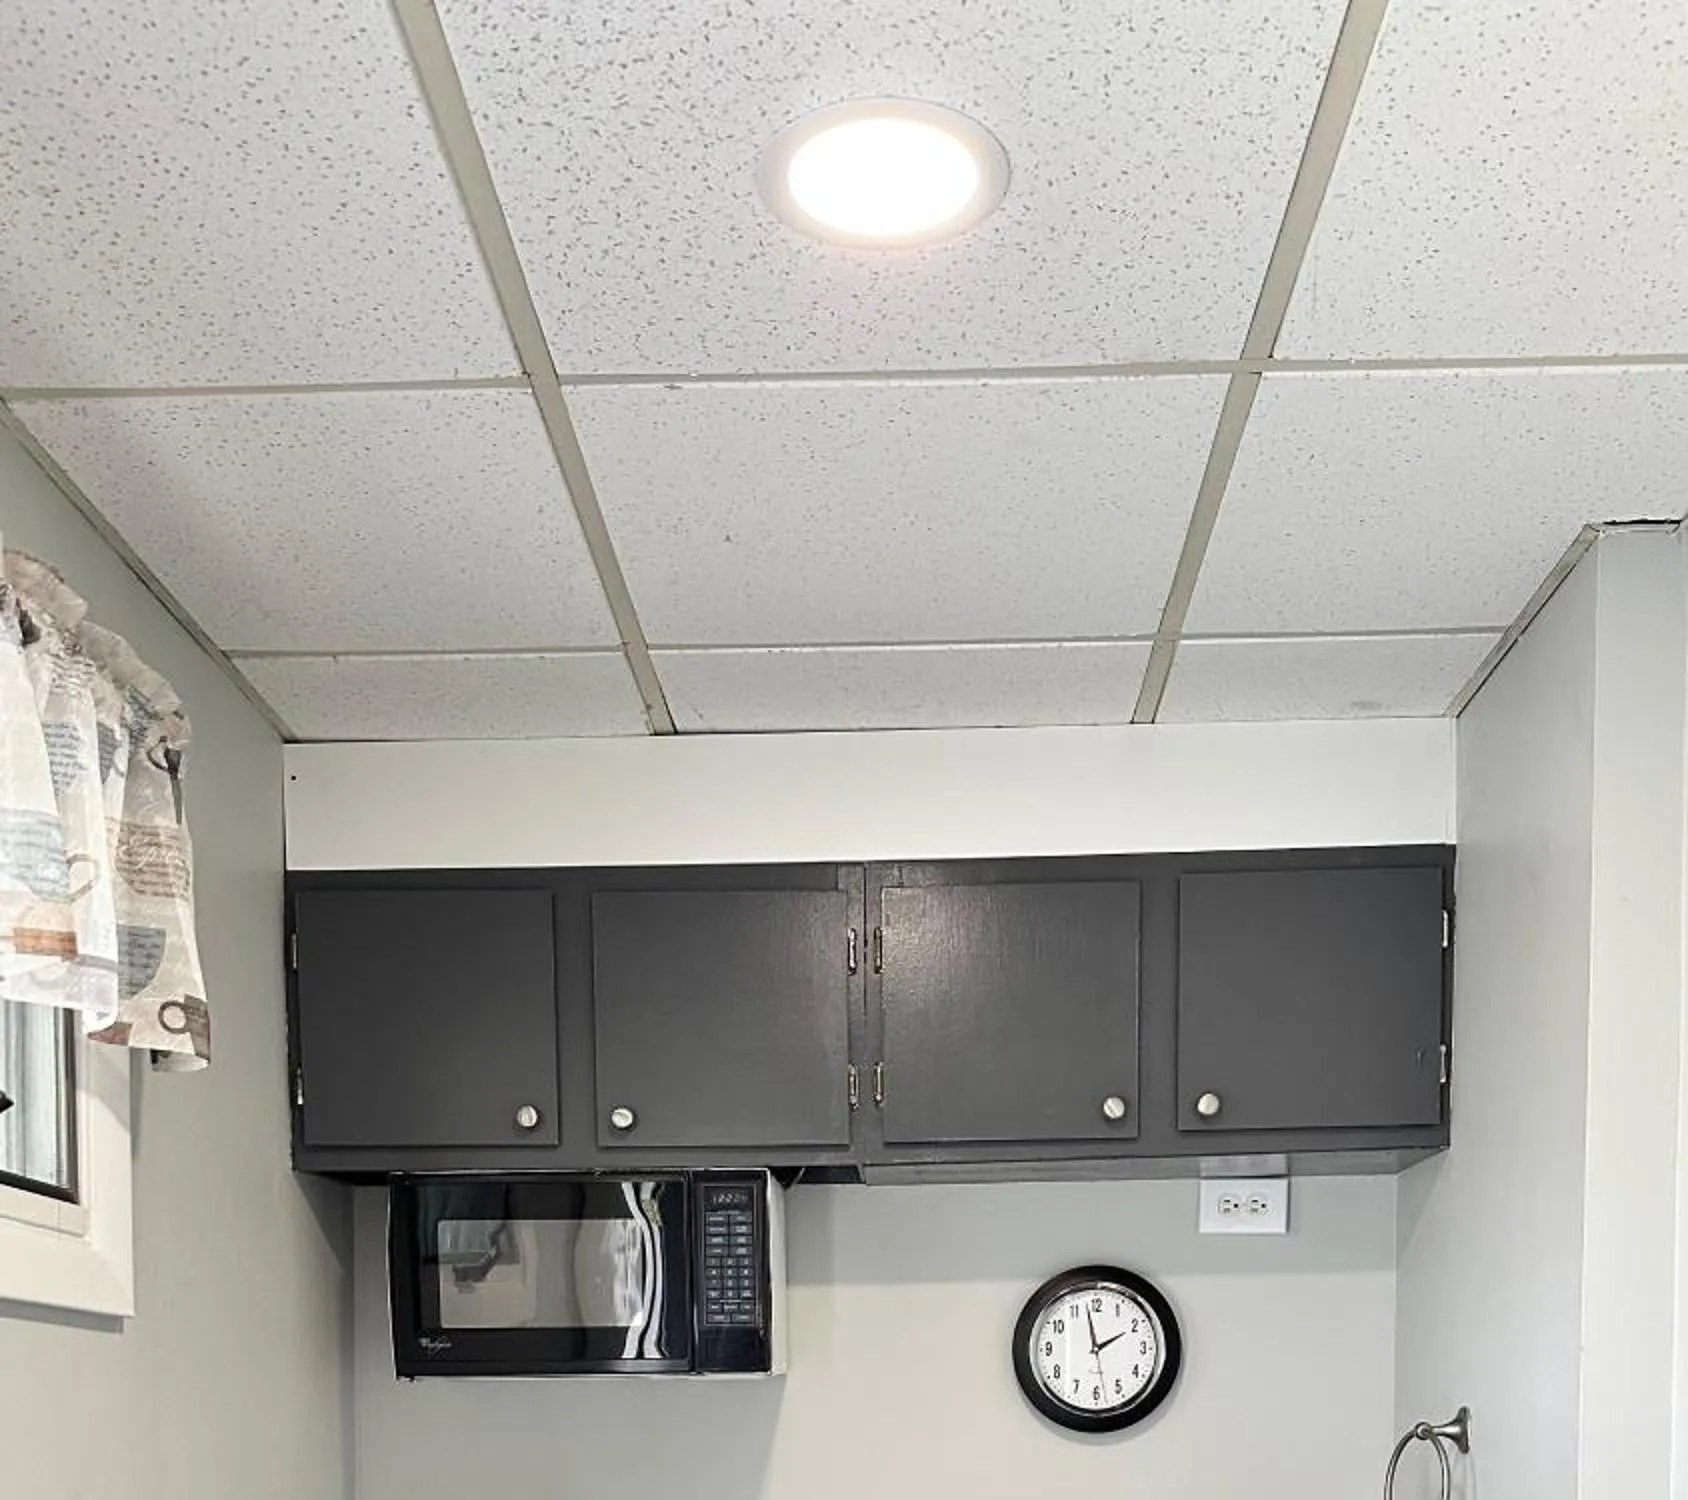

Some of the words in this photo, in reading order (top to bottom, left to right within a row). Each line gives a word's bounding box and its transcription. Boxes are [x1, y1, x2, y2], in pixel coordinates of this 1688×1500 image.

[1070, 1304, 1079, 1319] 11
[1092, 1299, 1103, 1312] 12
[1115, 1304, 1121, 1317] 1
[1052, 1320, 1065, 1333] 10
[1131, 1319, 1139, 1333] 2
[1045, 1342, 1053, 1356] 9
[1140, 1342, 1147, 1355] 3
[1053, 1364, 1061, 1378] 8
[1132, 1364, 1139, 1378] 4
[1074, 1380, 1080, 1394] 7
[1093, 1386, 1100, 1400] 6
[1115, 1380, 1123, 1394] 5
